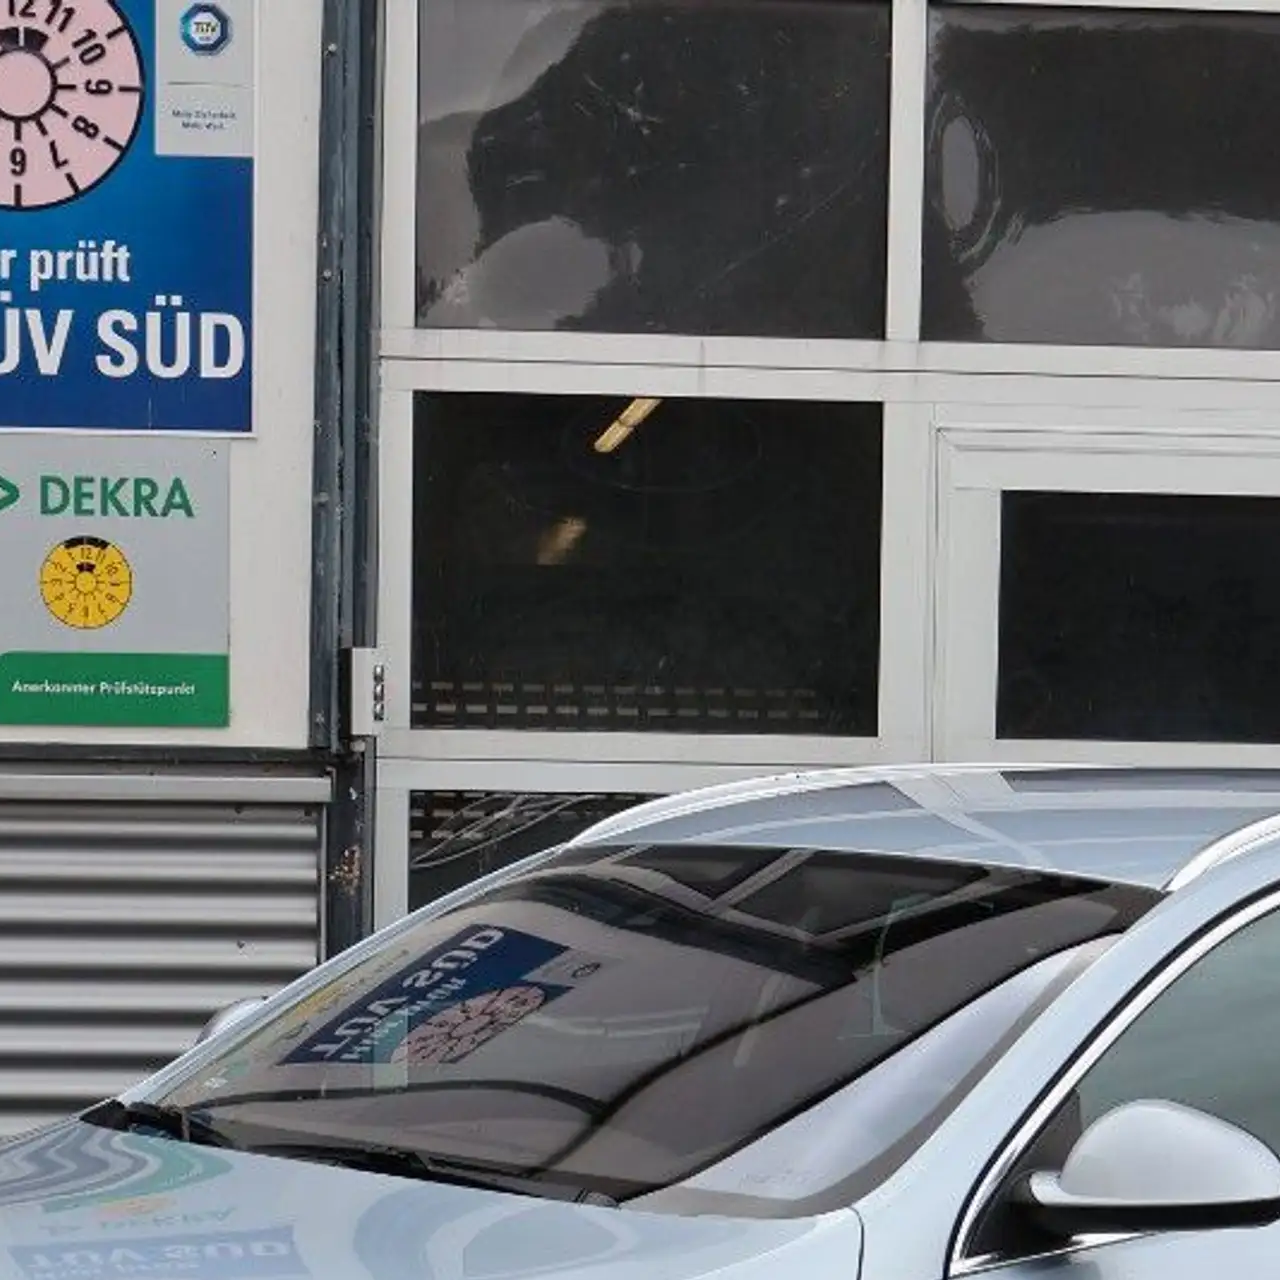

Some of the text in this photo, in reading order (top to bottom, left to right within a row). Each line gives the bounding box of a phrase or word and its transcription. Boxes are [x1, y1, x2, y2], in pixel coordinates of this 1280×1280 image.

[9, 0, 36, 17] 12
[44, 0, 75, 33] 11
[71, 28, 107, 66] 10
[85, 78, 113, 96] 9
[71, 115, 100, 139] 8
[9, 148, 27, 177] 6
[49, 140, 69, 169] 7
[30, 239, 131, 292] prüft
[96, 294, 245, 379] SÜD
[40, 475, 195, 519] DEKRA
[11, 679, 195, 697] Anerkannter Prüfstützpunkt
